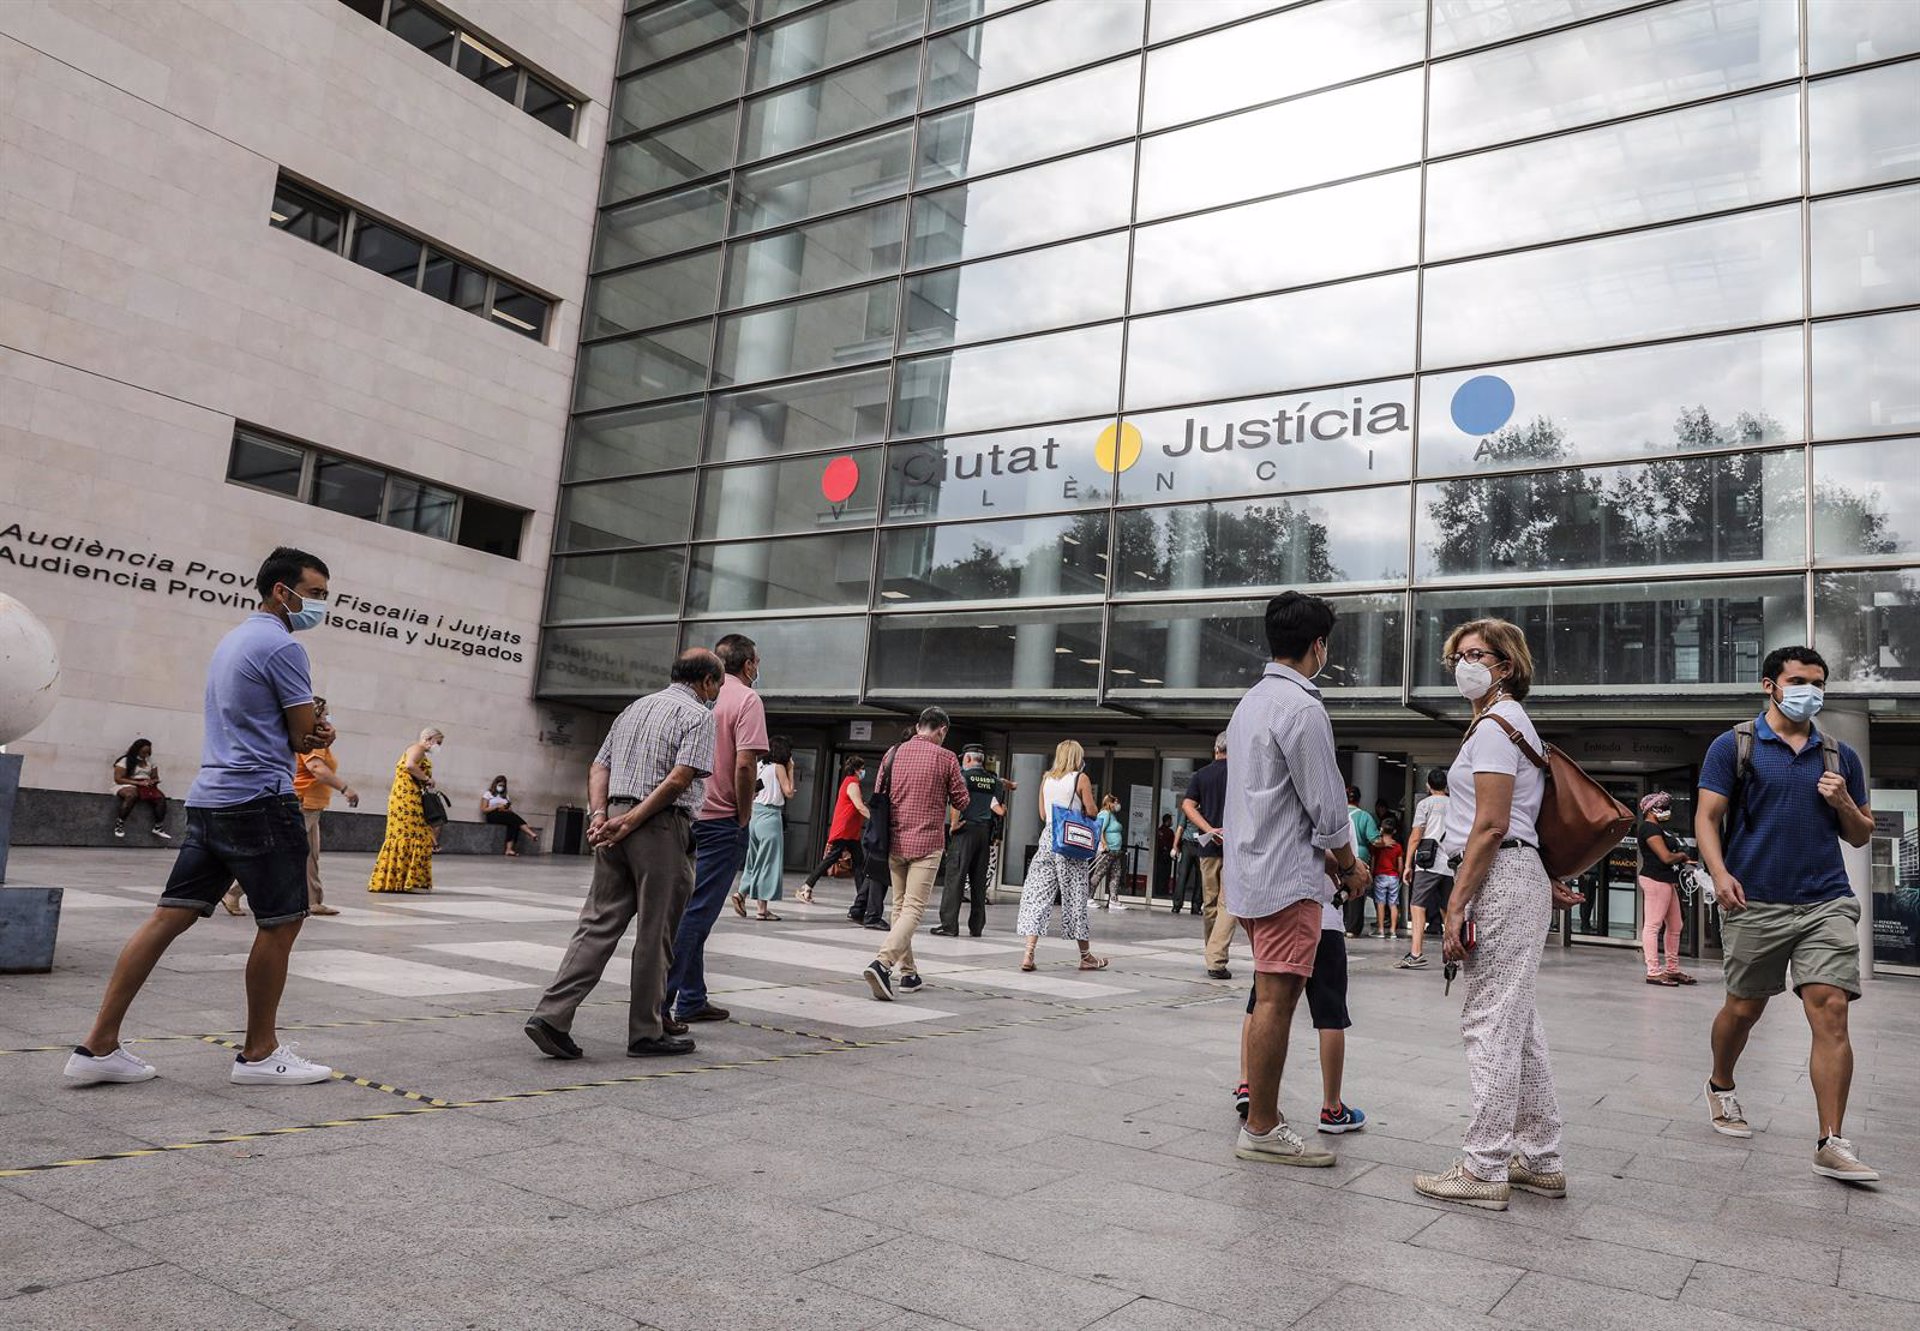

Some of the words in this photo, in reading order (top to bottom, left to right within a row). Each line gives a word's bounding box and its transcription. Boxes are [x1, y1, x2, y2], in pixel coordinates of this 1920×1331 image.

[903, 437, 1060, 486] Ciutat
[1162, 396, 1410, 458] Justícia
[0, 523, 175, 573] Audiència
[334, 592, 430, 626] Fiscalia
[436, 614, 444, 629] i
[448, 618, 522, 646] Jutjats
[0, 545, 157, 592] Audiencia
[168, 579, 262, 611] Provin
[324, 611, 399, 640] iscalía
[405, 629, 419, 646] y
[424, 632, 524, 664] Juzgados
